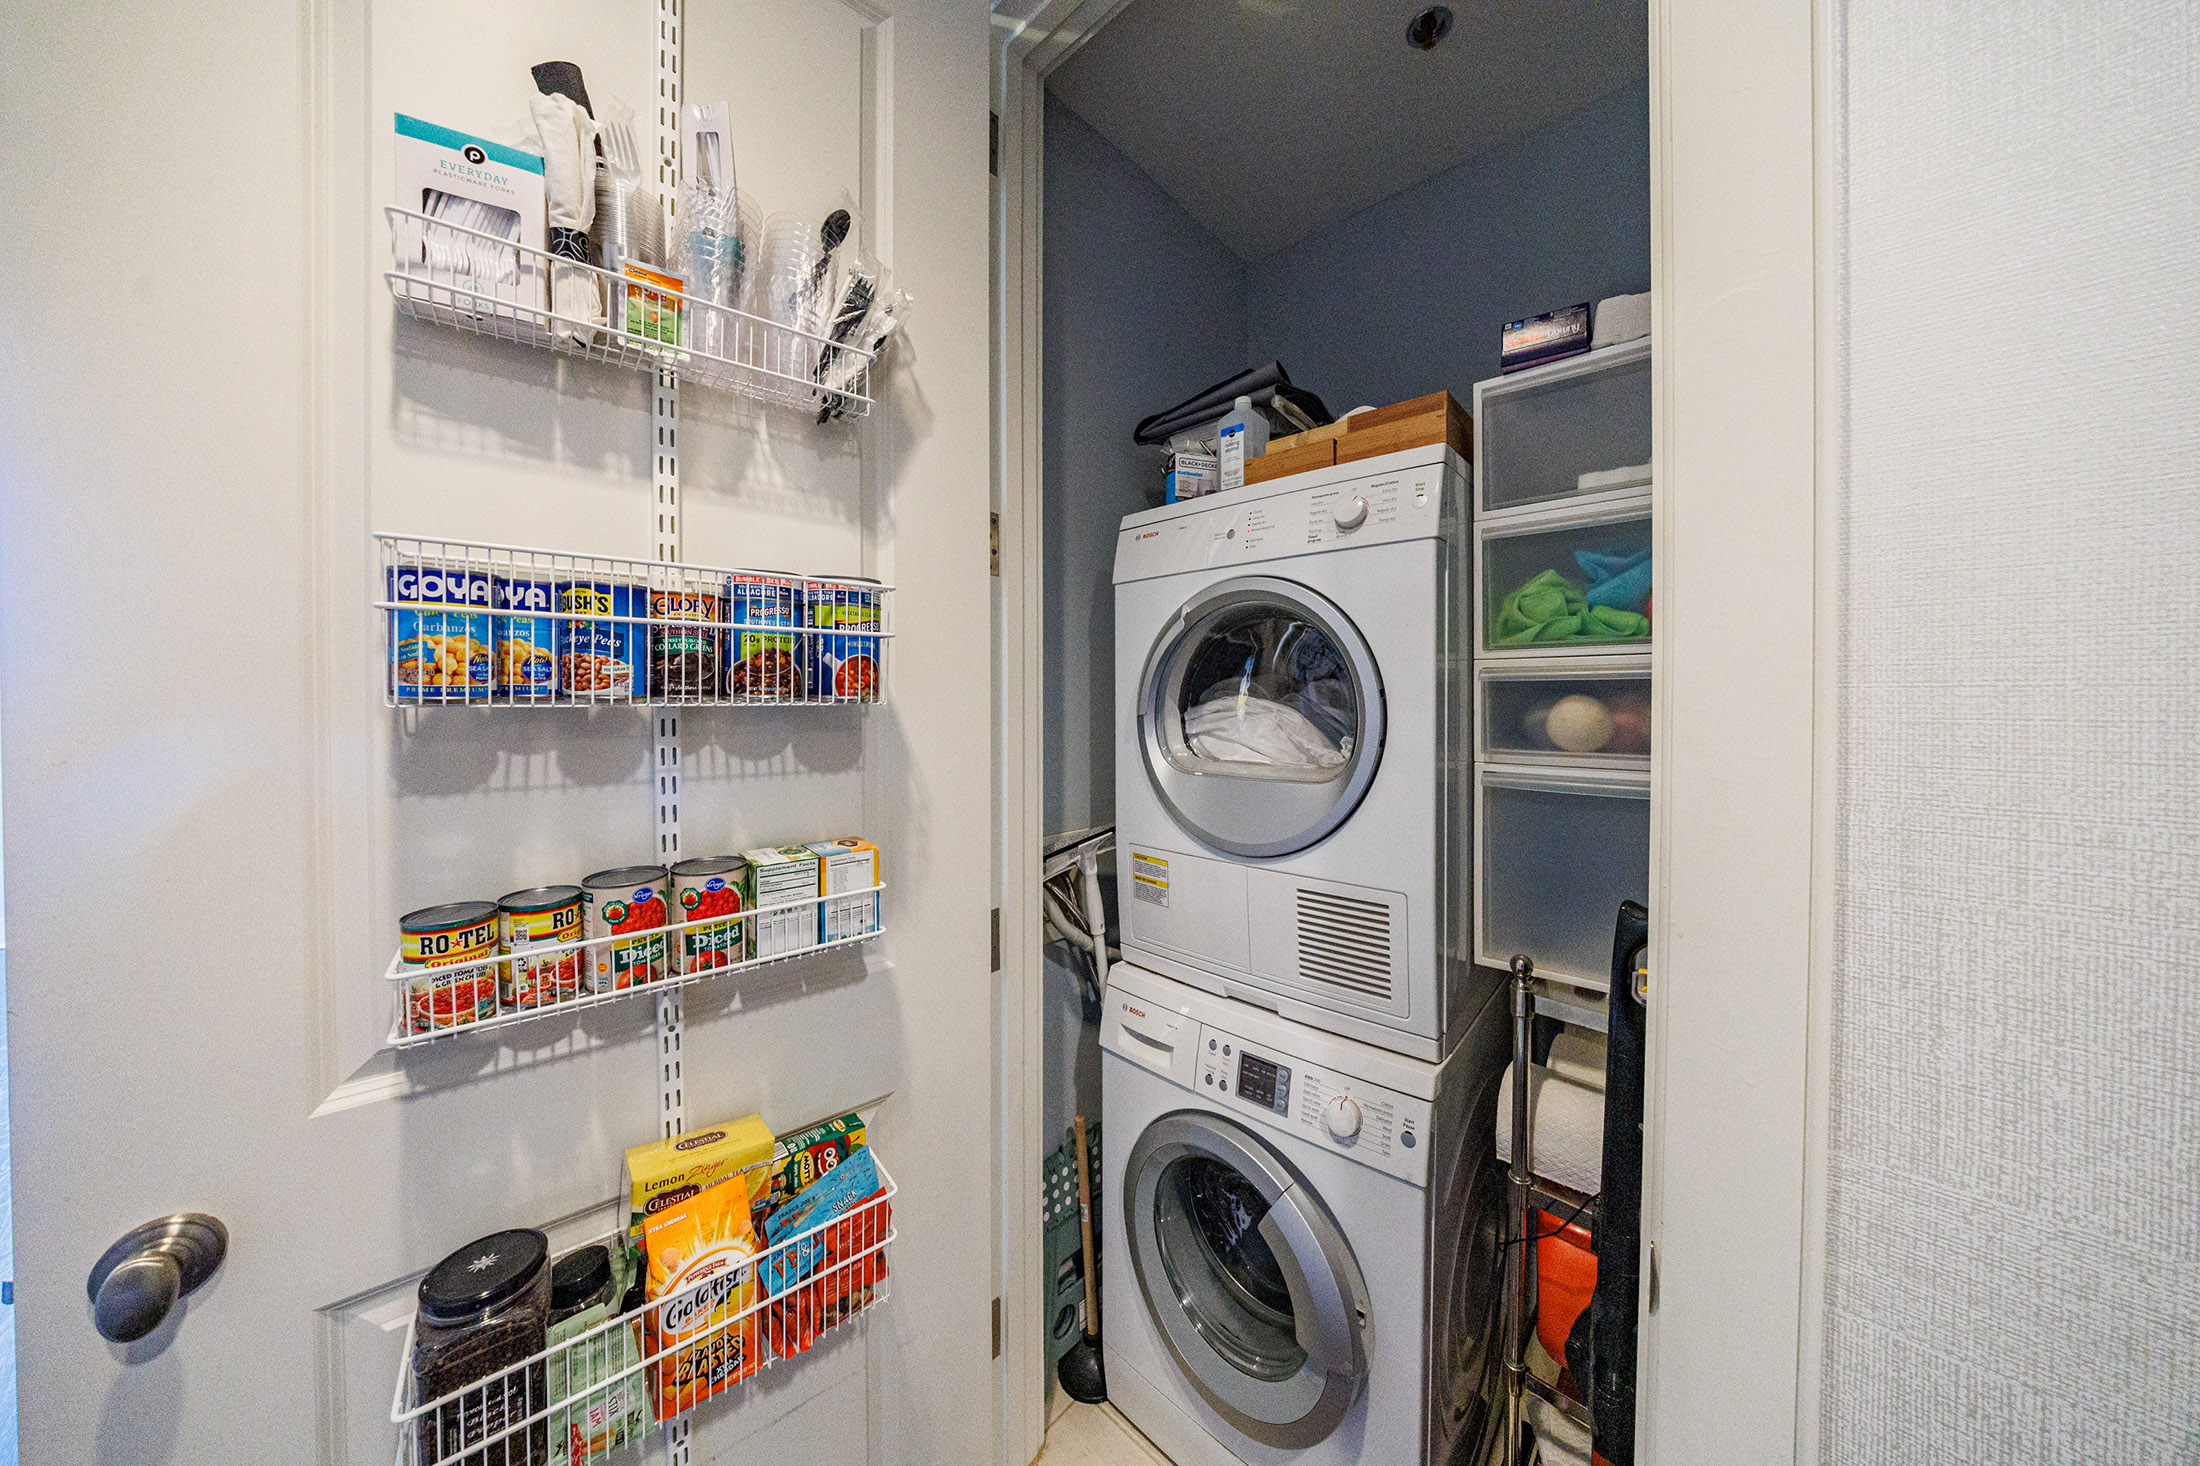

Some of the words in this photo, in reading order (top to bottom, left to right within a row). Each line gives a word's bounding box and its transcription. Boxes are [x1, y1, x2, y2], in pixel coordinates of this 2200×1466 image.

[433, 168, 488, 188] PLASTICWARE
[440, 159, 509, 186] EVERYDAY
[1142, 531, 1159, 539] BOSCH
[398, 574, 489, 602] GOYA
[500, 587, 546, 608] YA
[737, 588, 776, 597] ALACRE
[654, 596, 714, 620] GLORY
[654, 642, 688, 652] COLARD
[690, 643, 713, 653] GRENS
[759, 862, 797, 873] Supplement
[798, 860, 816, 868] Facts
[706, 880, 725, 890] Kroger
[634, 890, 653, 900] Kroger
[419, 936, 450, 956] RO
[458, 923, 495, 949] TEL
[692, 925, 740, 948] Diced
[430, 949, 489, 968] Original
[441, 977, 464, 987] GREN
[1129, 1006, 1146, 1018] BOSCH
[1402, 1122, 1415, 1131] Pause
[1404, 1117, 1415, 1125] Start
[677, 1132, 725, 1150] CELESTIAL
[644, 1173, 686, 1193] Lemon
[686, 1158, 728, 1182] Zinger
[647, 1189, 696, 1211] CELESTIAL
[831, 1188, 858, 1214] SNACK
[647, 1223, 664, 1235] XTRA
[664, 1213, 688, 1227] CHEDDAR
[800, 1242, 811, 1258] &
[674, 1336, 746, 1383] BLASTED
[608, 1395, 620, 1418] STIX
